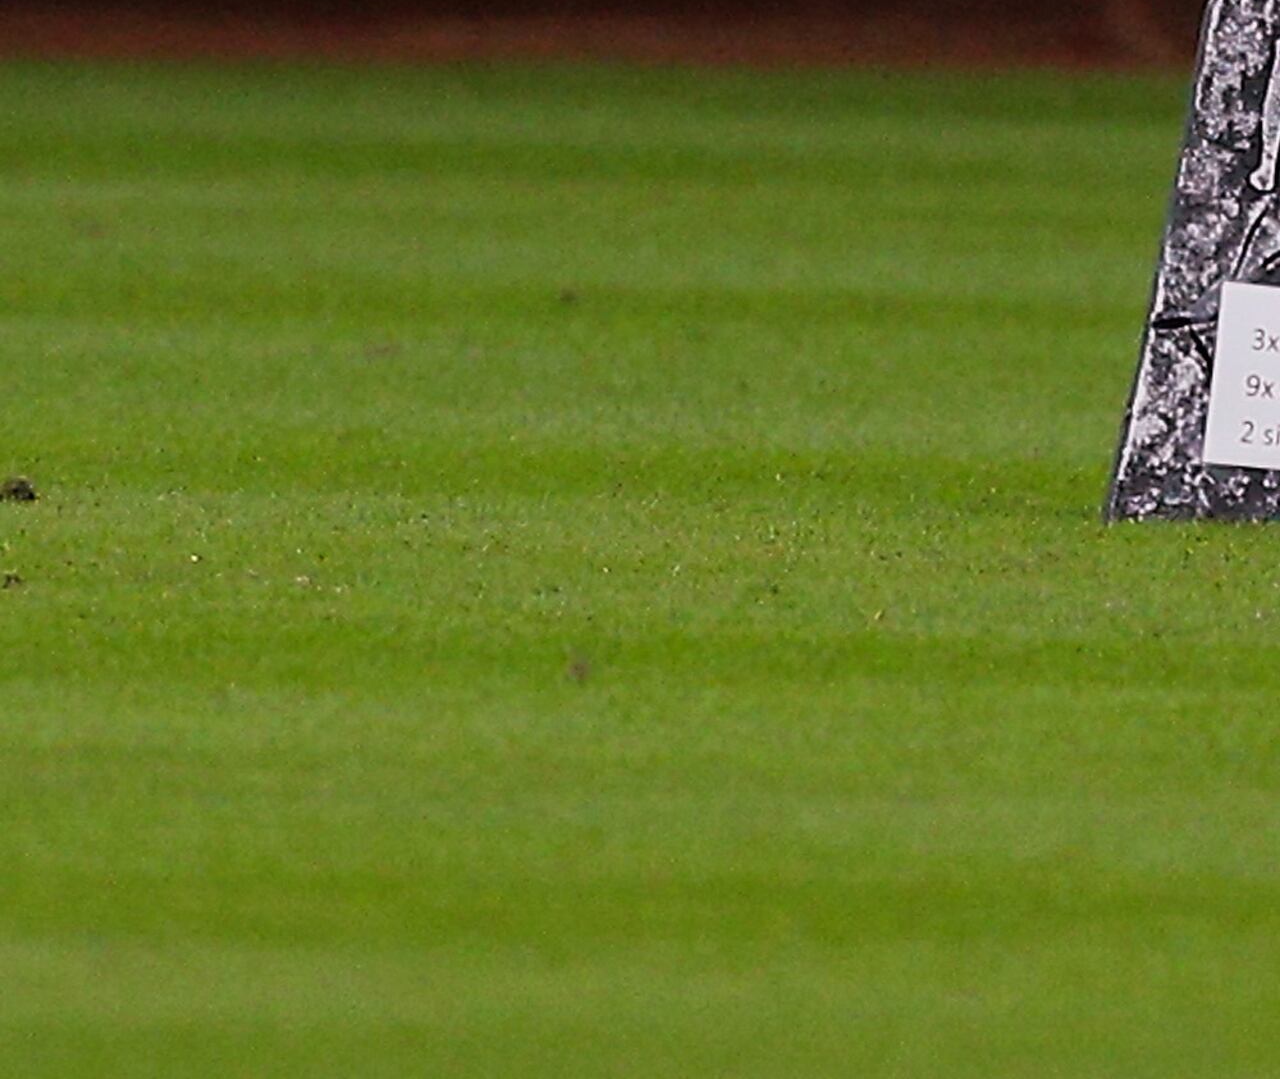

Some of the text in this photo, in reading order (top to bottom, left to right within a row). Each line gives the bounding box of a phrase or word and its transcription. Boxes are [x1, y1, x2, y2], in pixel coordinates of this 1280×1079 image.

[1251, 327, 1280, 353] 3x
[1245, 373, 1275, 399] 9x
[1239, 420, 1255, 445] 2
